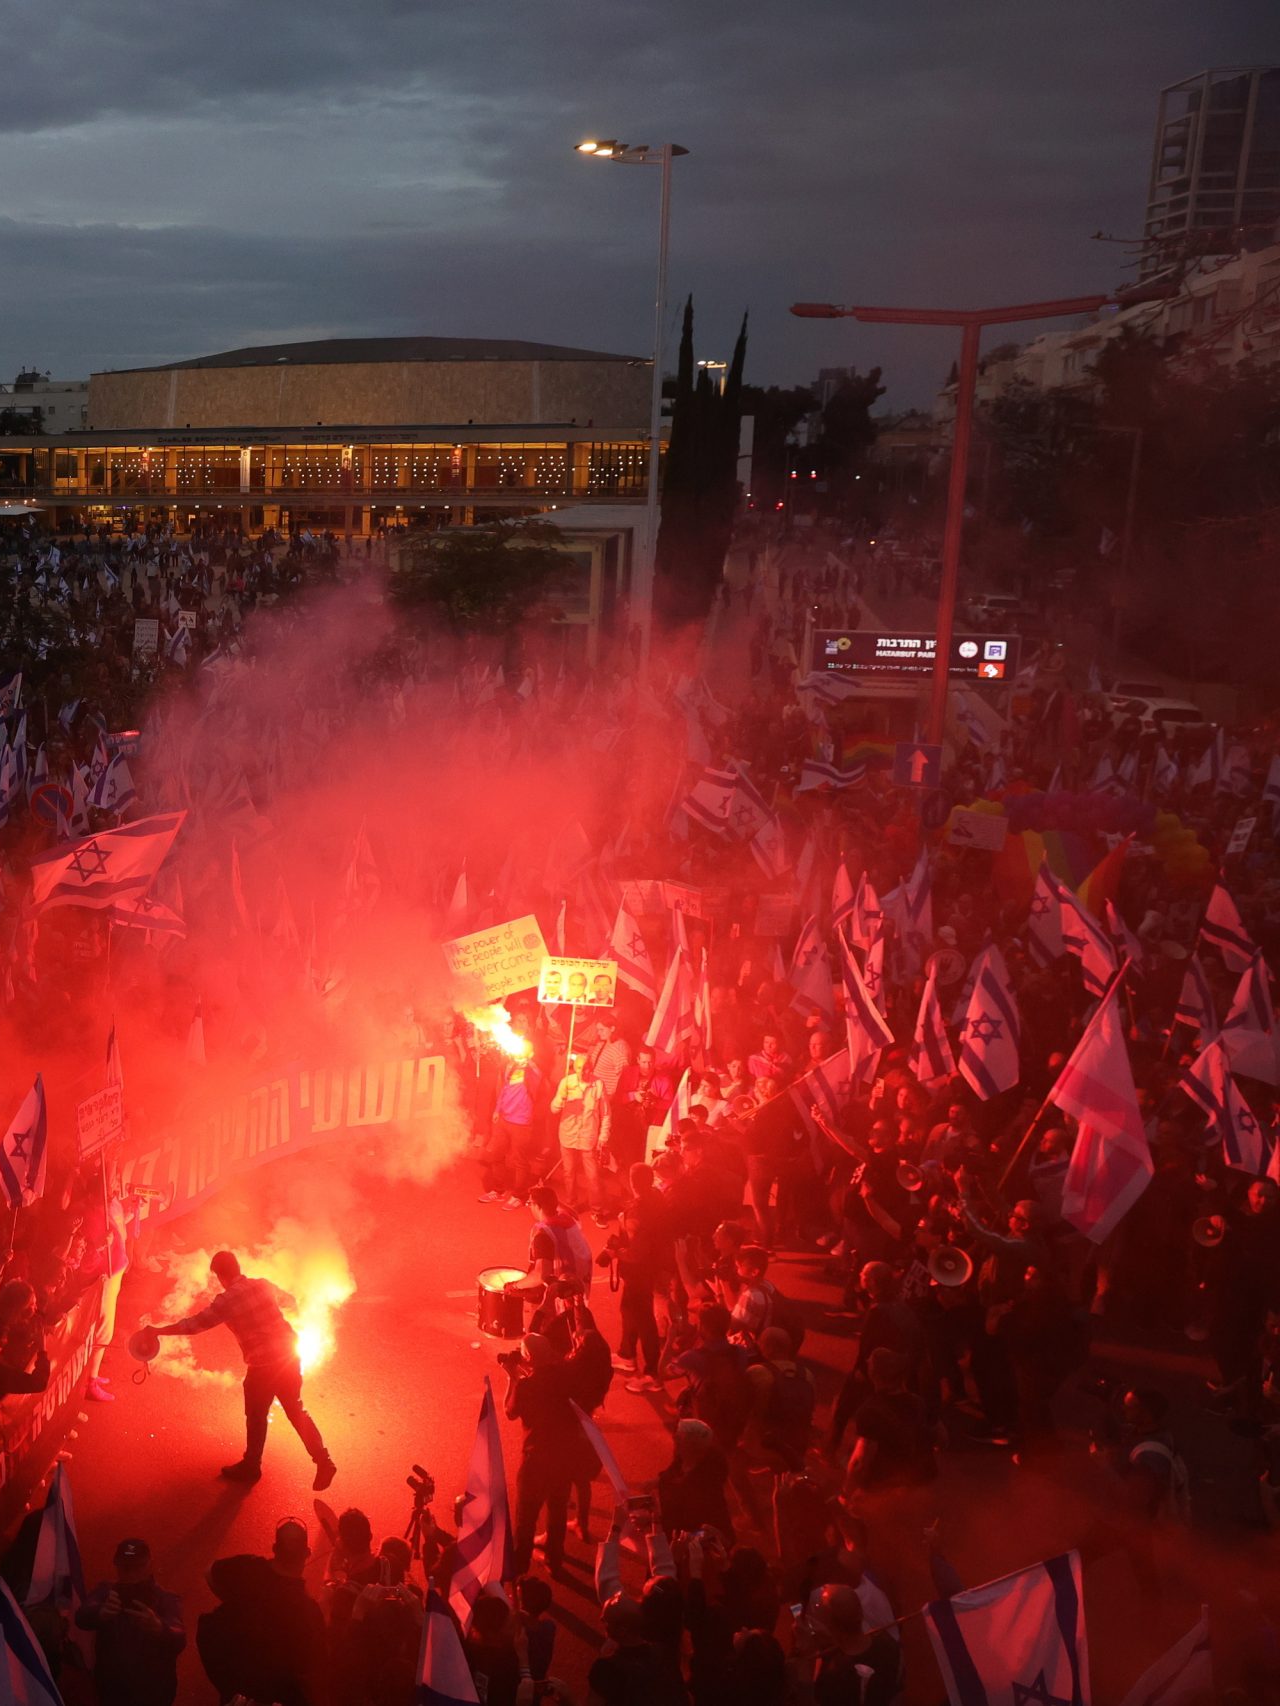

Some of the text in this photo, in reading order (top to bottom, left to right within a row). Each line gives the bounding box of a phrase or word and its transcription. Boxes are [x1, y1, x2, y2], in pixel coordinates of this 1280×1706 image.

[875, 650, 917, 658] HATARBUT
[877, 638, 921, 648] התרבות
[473, 935, 501, 953] power
[503, 924, 515, 939] of
[451, 937, 522, 970] the people will
[471, 951, 538, 980] overcome
